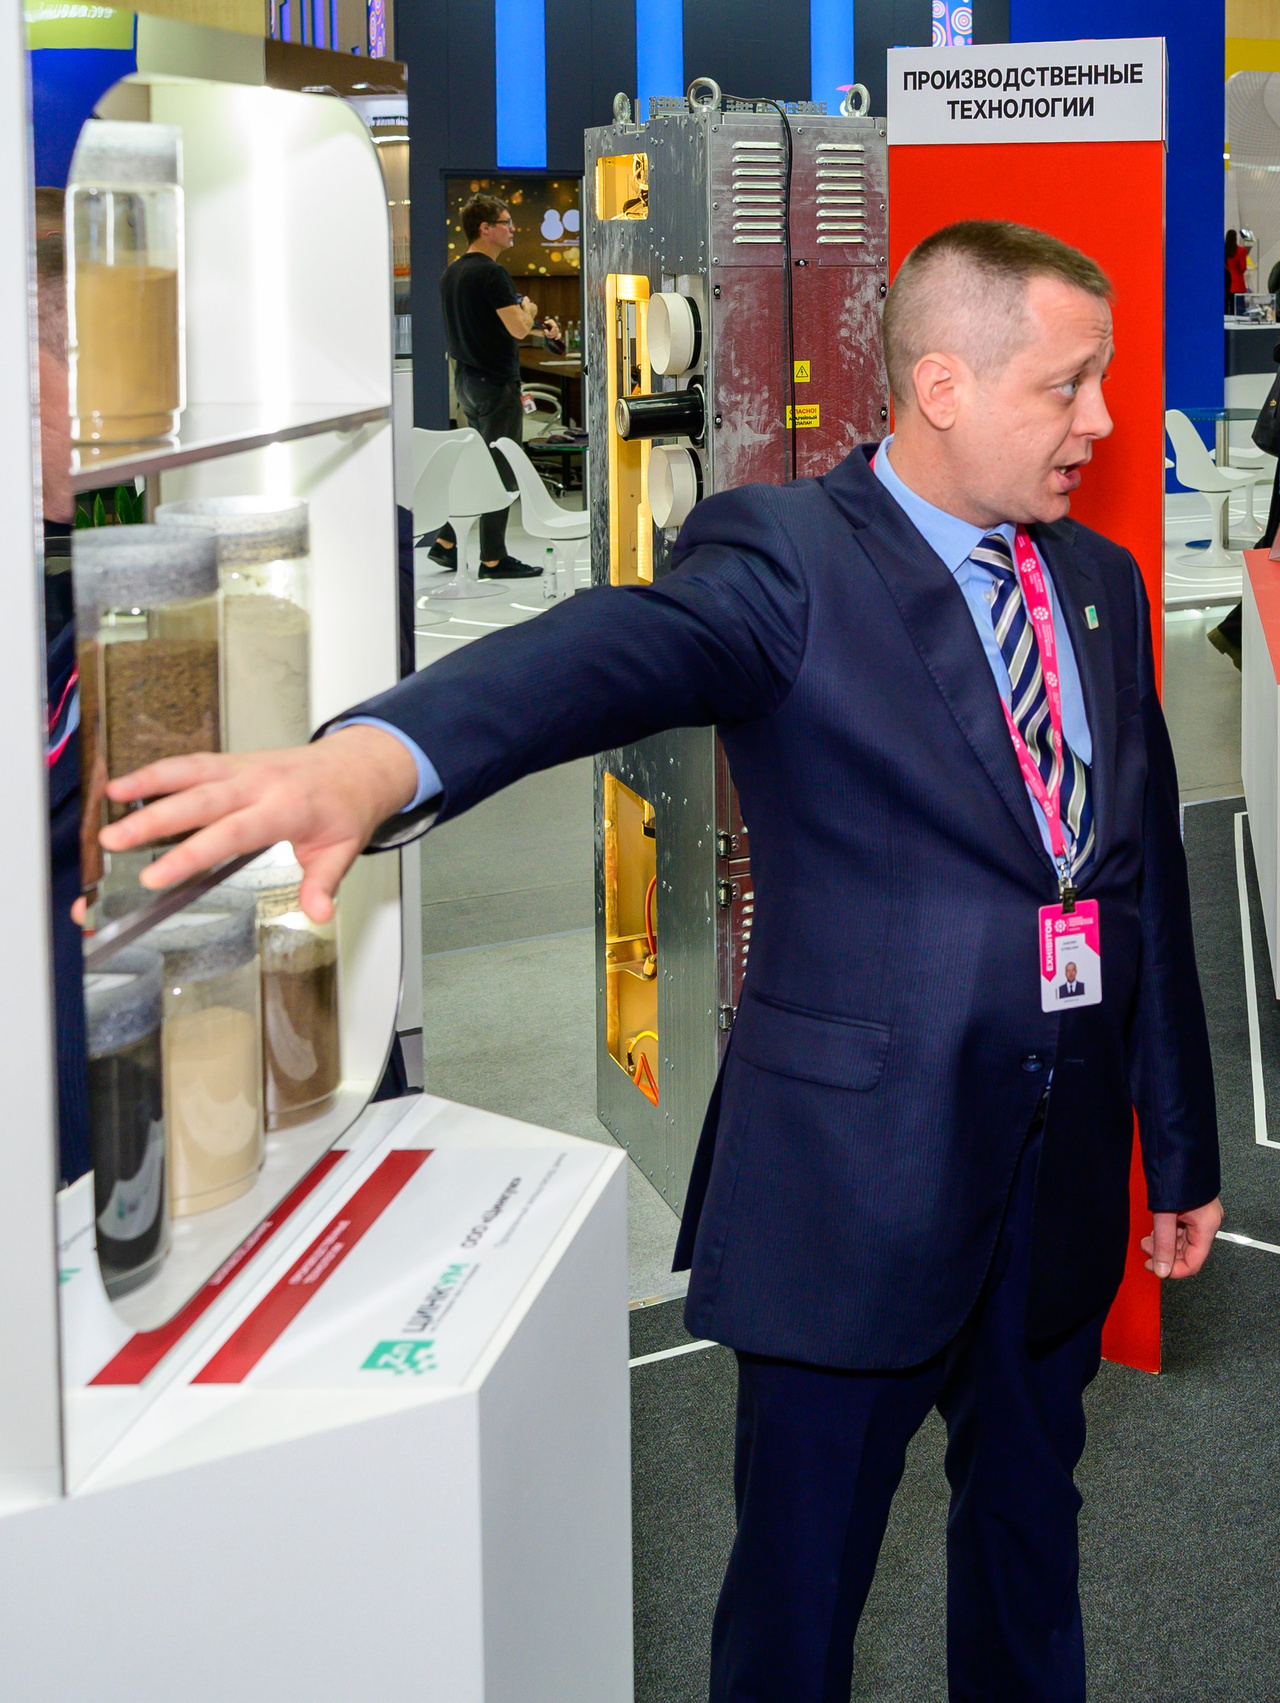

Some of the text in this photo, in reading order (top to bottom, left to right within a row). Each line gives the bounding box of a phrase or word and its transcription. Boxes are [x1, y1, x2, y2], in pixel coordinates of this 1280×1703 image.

[903, 63, 1143, 92] ПРОИЗВОДСТВЕННЫЕ
[947, 97, 1094, 120] ТЕХНОЛОГИИ
[1044, 918, 1054, 972] EXHIBITOR
